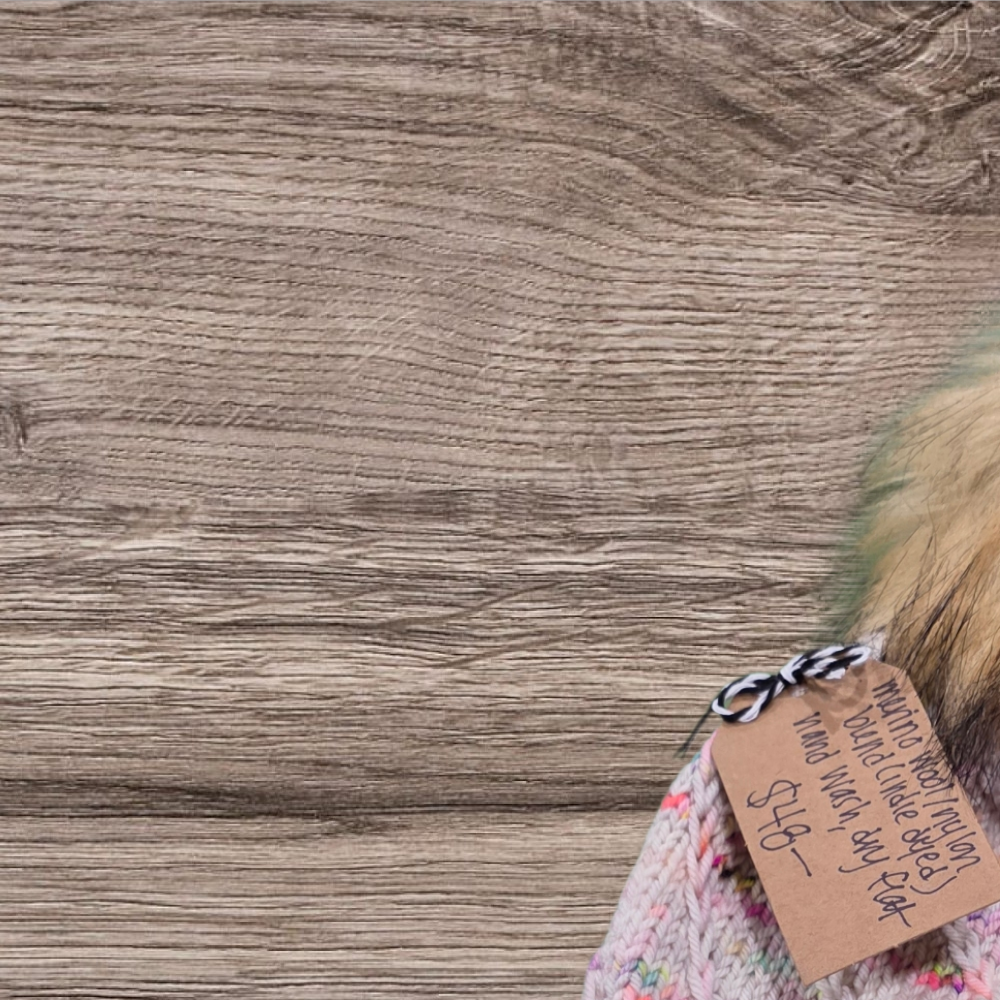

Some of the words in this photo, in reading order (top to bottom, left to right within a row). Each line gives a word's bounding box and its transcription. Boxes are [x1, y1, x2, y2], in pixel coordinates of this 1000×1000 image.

[843, 704, 895, 768] blend
[897, 825, 957, 894] dyed)
[872, 678, 923, 749] merino
[793, 711, 841, 765] hand
[838, 827, 890, 873] dry
[867, 870, 917, 928] flat
